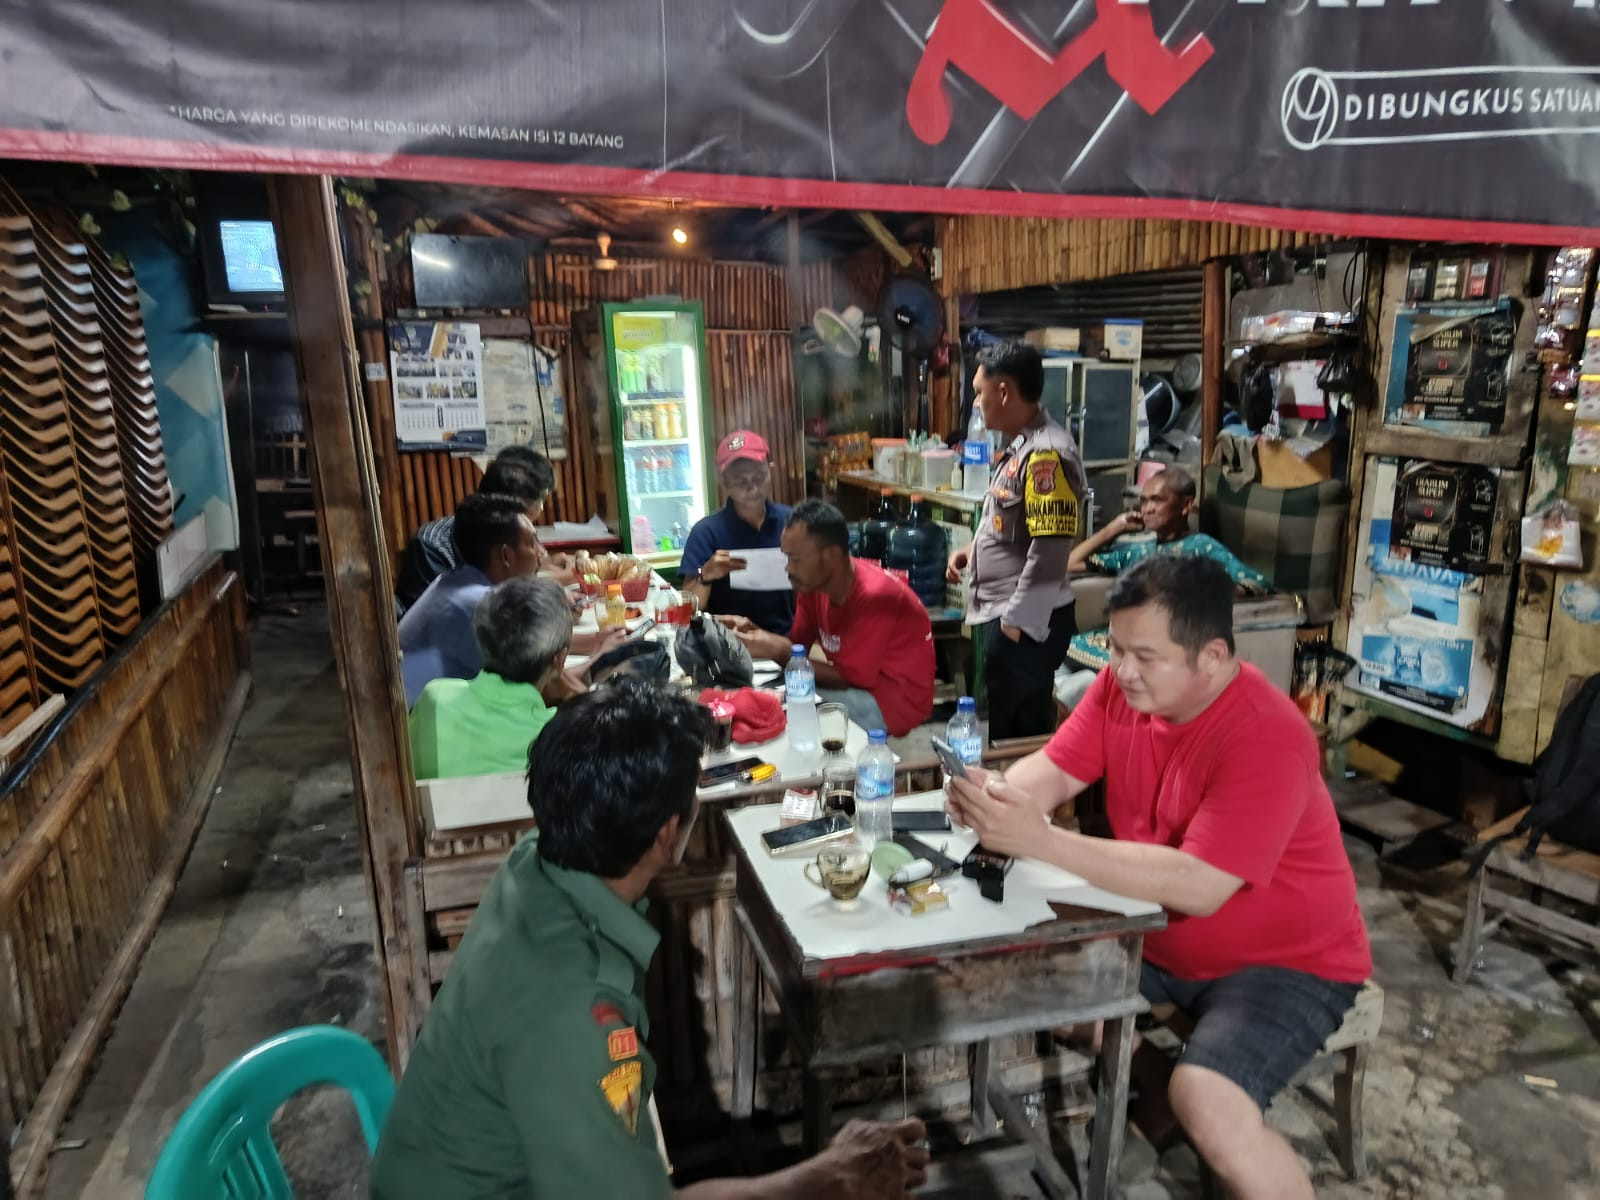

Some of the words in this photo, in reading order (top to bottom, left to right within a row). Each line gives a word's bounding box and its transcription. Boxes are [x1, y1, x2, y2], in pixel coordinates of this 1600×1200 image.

[1344, 88, 1523, 121] DIBUNGKUS
[240, 110, 285, 126] YANG
[290, 114, 455, 138] DIREKOMENDASIKAN,
[459, 125, 529, 142] KEMASAN
[534, 130, 549, 143] ISI
[553, 131, 565, 144] 12
[569, 132, 624, 148] BATANG
